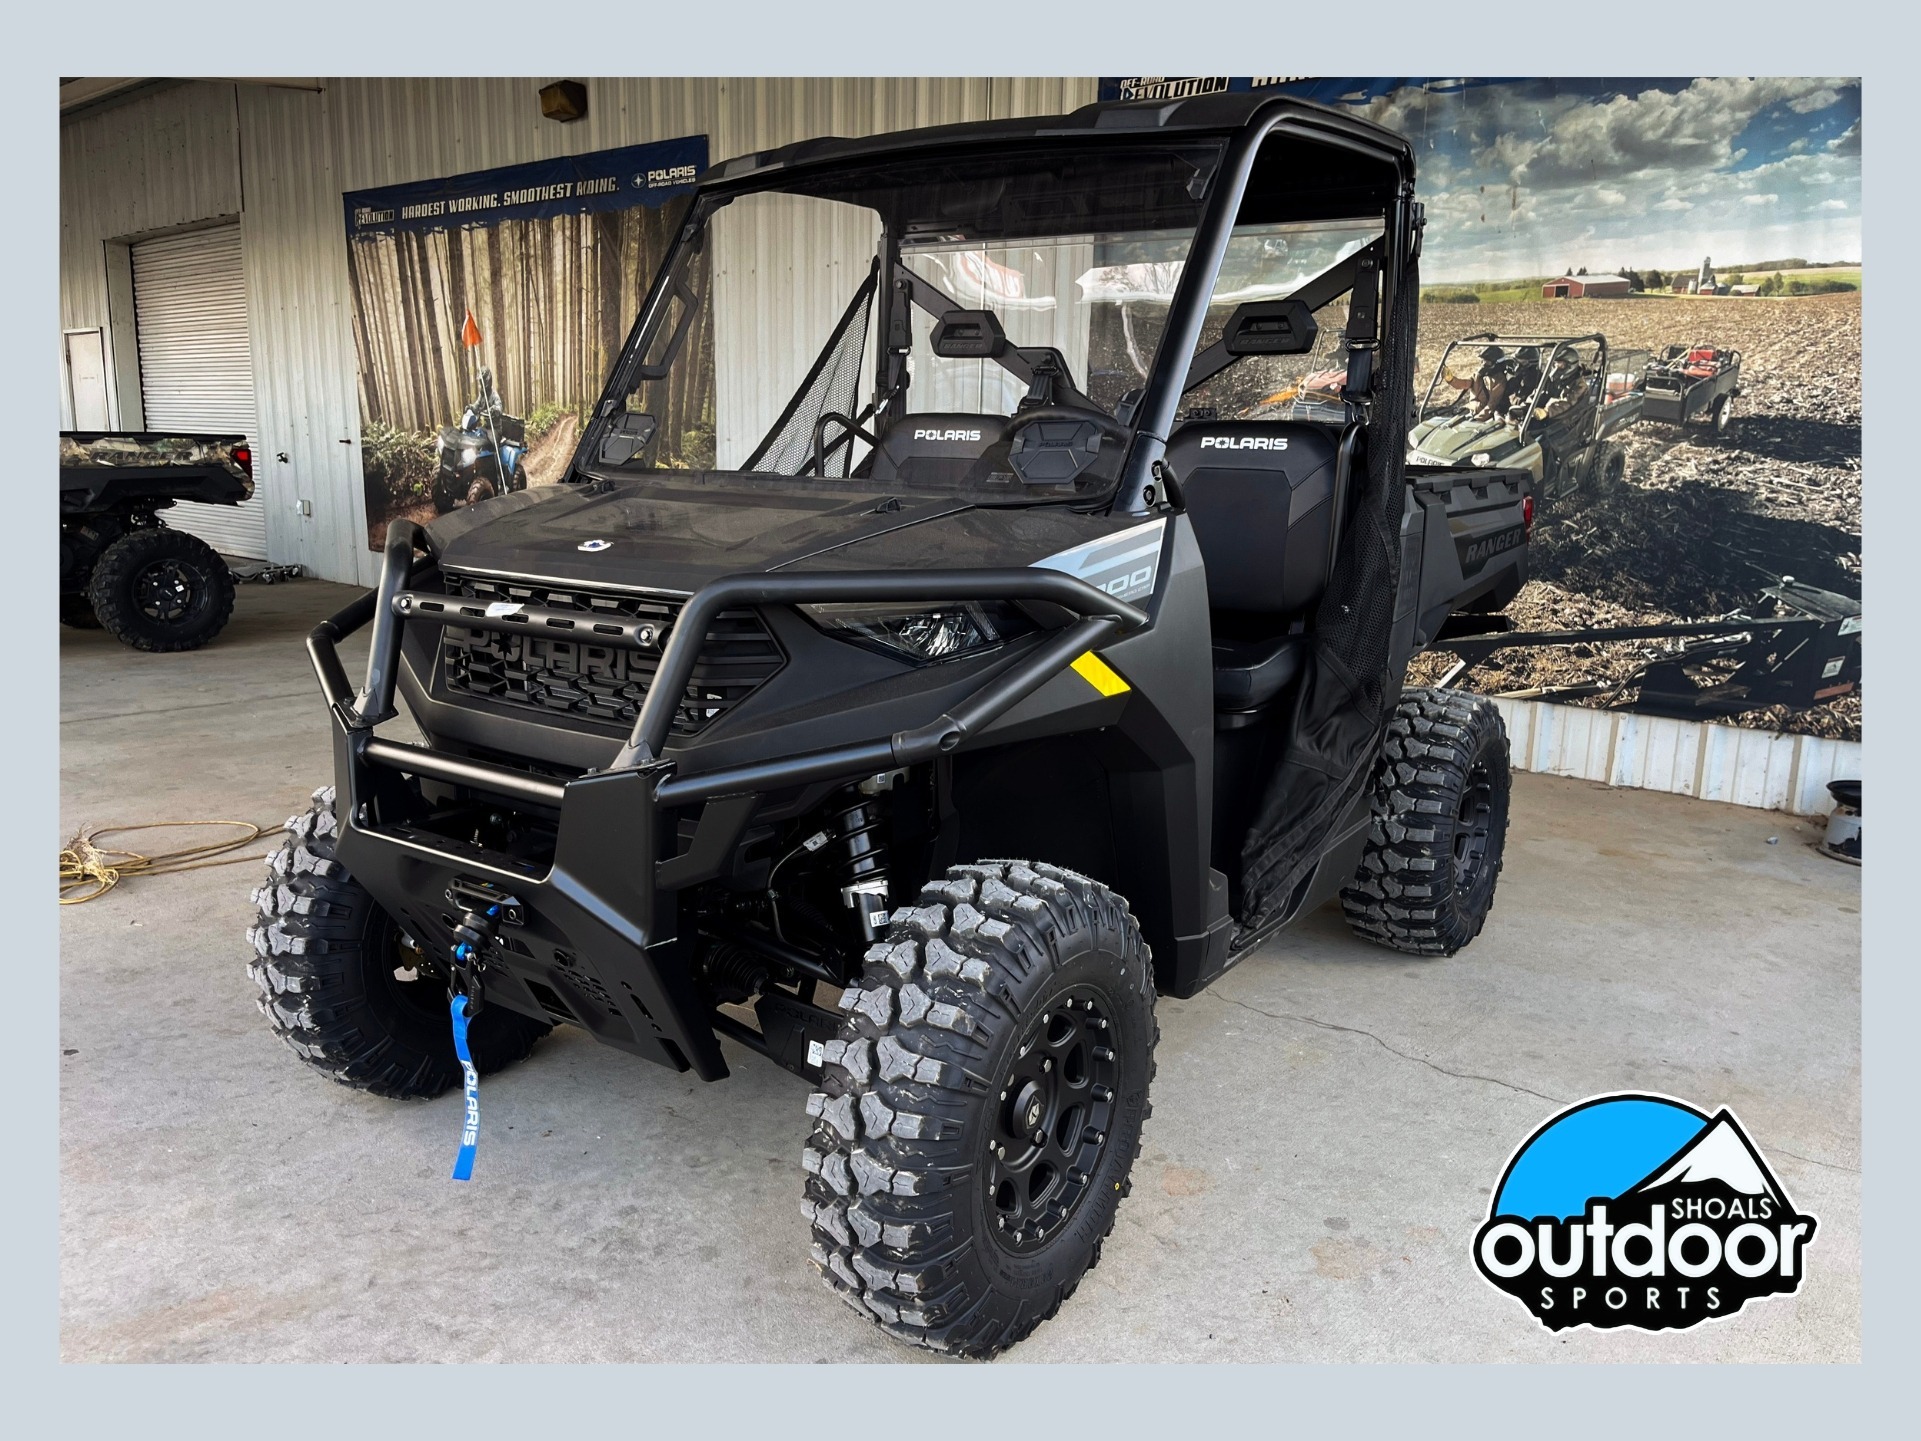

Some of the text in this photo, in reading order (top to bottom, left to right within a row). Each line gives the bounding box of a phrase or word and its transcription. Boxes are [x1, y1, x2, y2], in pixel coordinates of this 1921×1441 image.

[648, 165, 696, 182] POLARIS
[402, 176, 620, 220] HARDEST WORKING. SMOOTHEST RIDING.
[914, 429, 981, 441] POLARIS
[1200, 436, 1289, 451] POLARIS
[90, 451, 194, 462] RANGER
[1465, 528, 1522, 563] RANGER
[1096, 565, 1152, 595] 00
[461, 1060, 480, 1146] POLARIS
